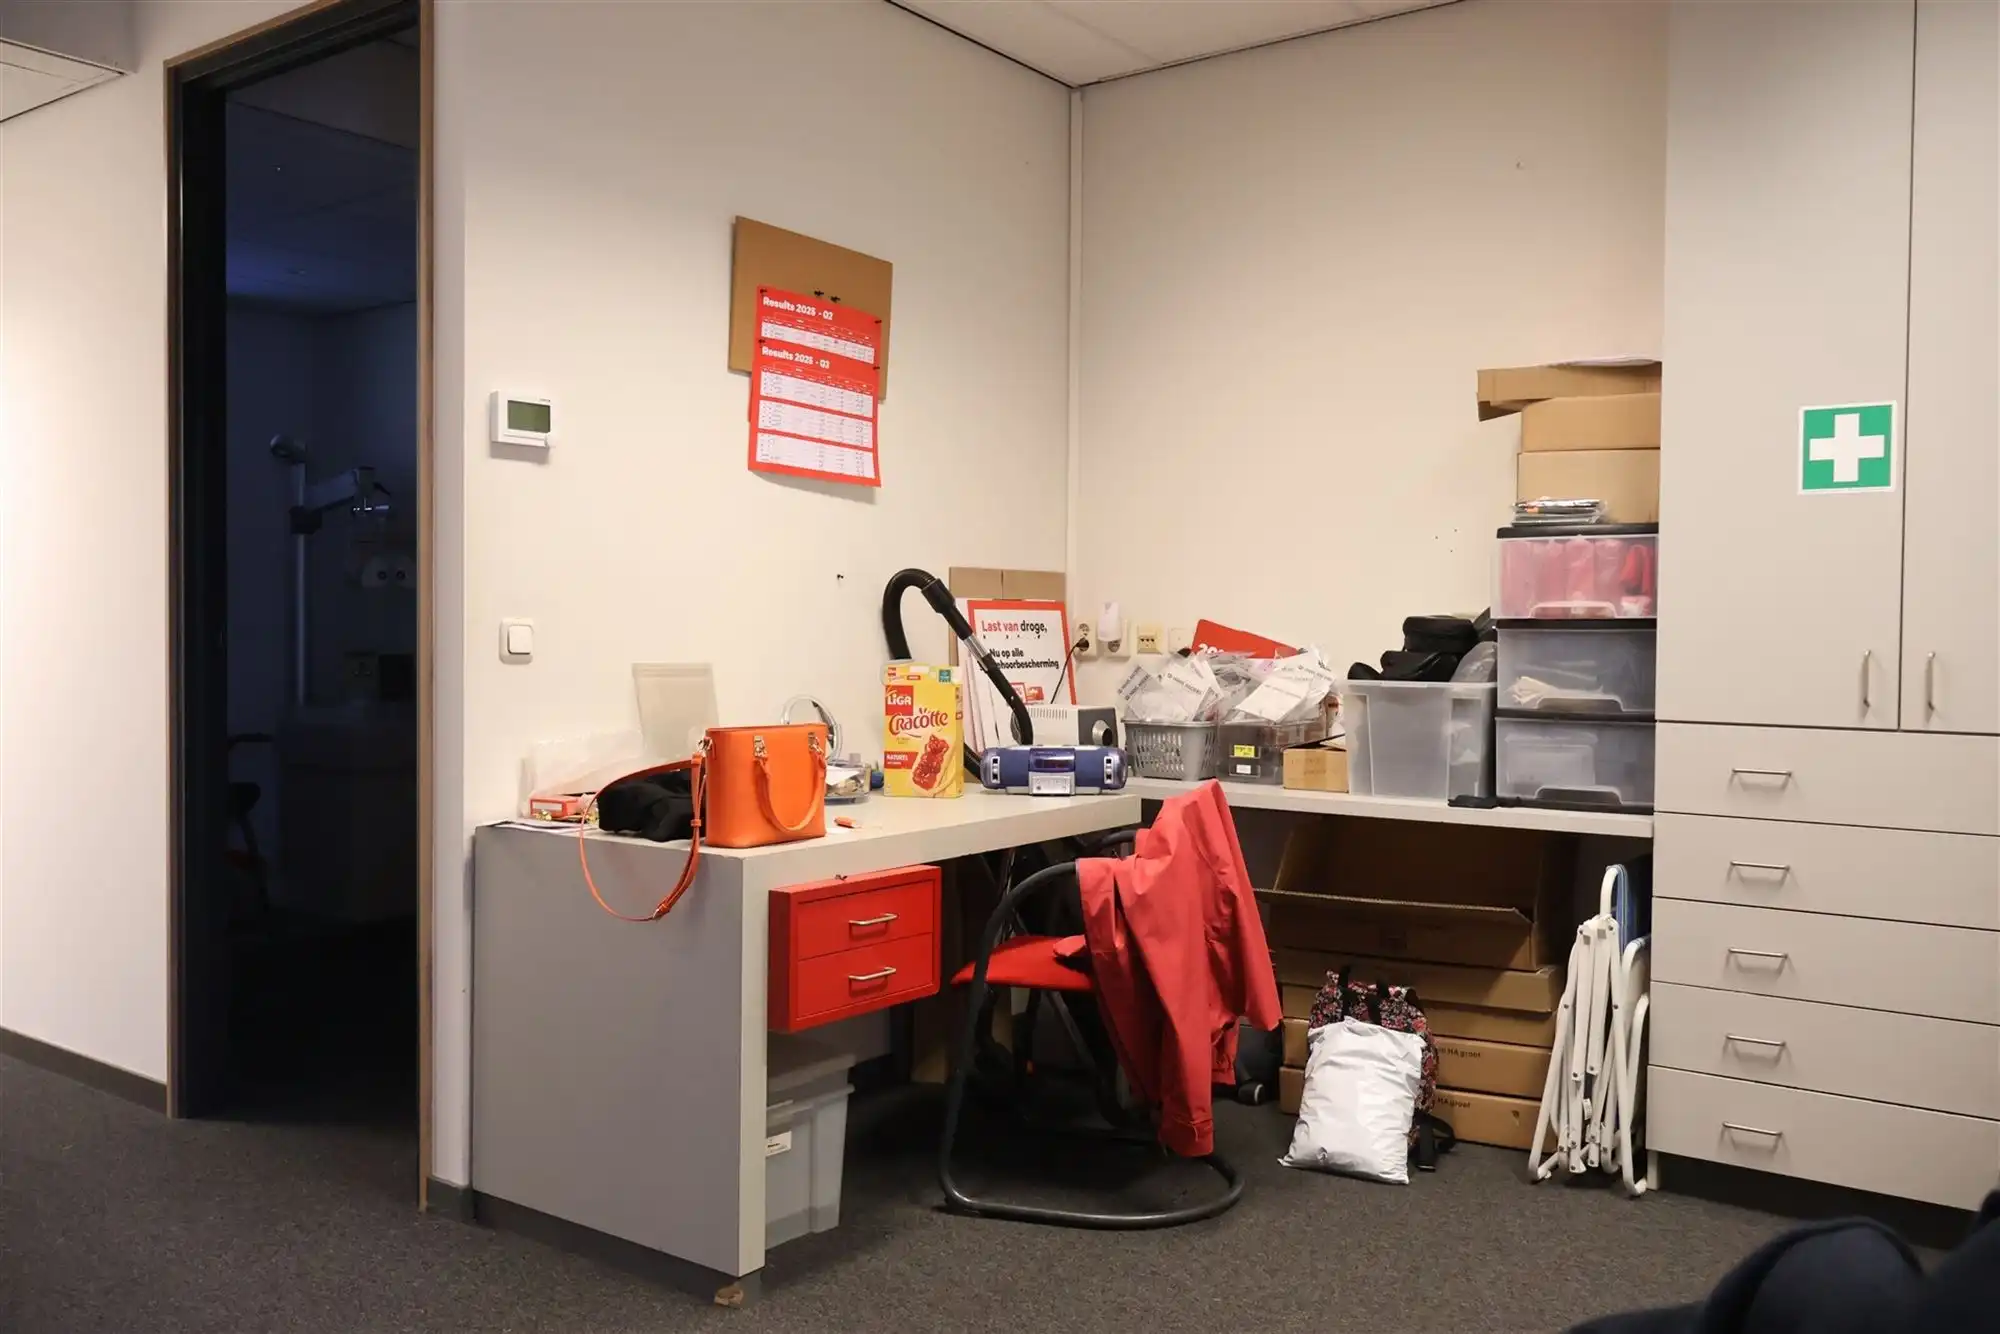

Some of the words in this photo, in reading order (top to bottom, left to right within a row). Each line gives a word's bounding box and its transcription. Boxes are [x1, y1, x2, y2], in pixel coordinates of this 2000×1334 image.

[763, 296, 795, 312] Results
[796, 304, 816, 316] 2025
[762, 346, 794, 361] Results
[982, 620, 1002, 632] Last
[1003, 622, 1019, 632] van
[1020, 620, 1048, 635] droge,
[1001, 650, 1010, 659] op
[1012, 648, 1024, 657] alle
